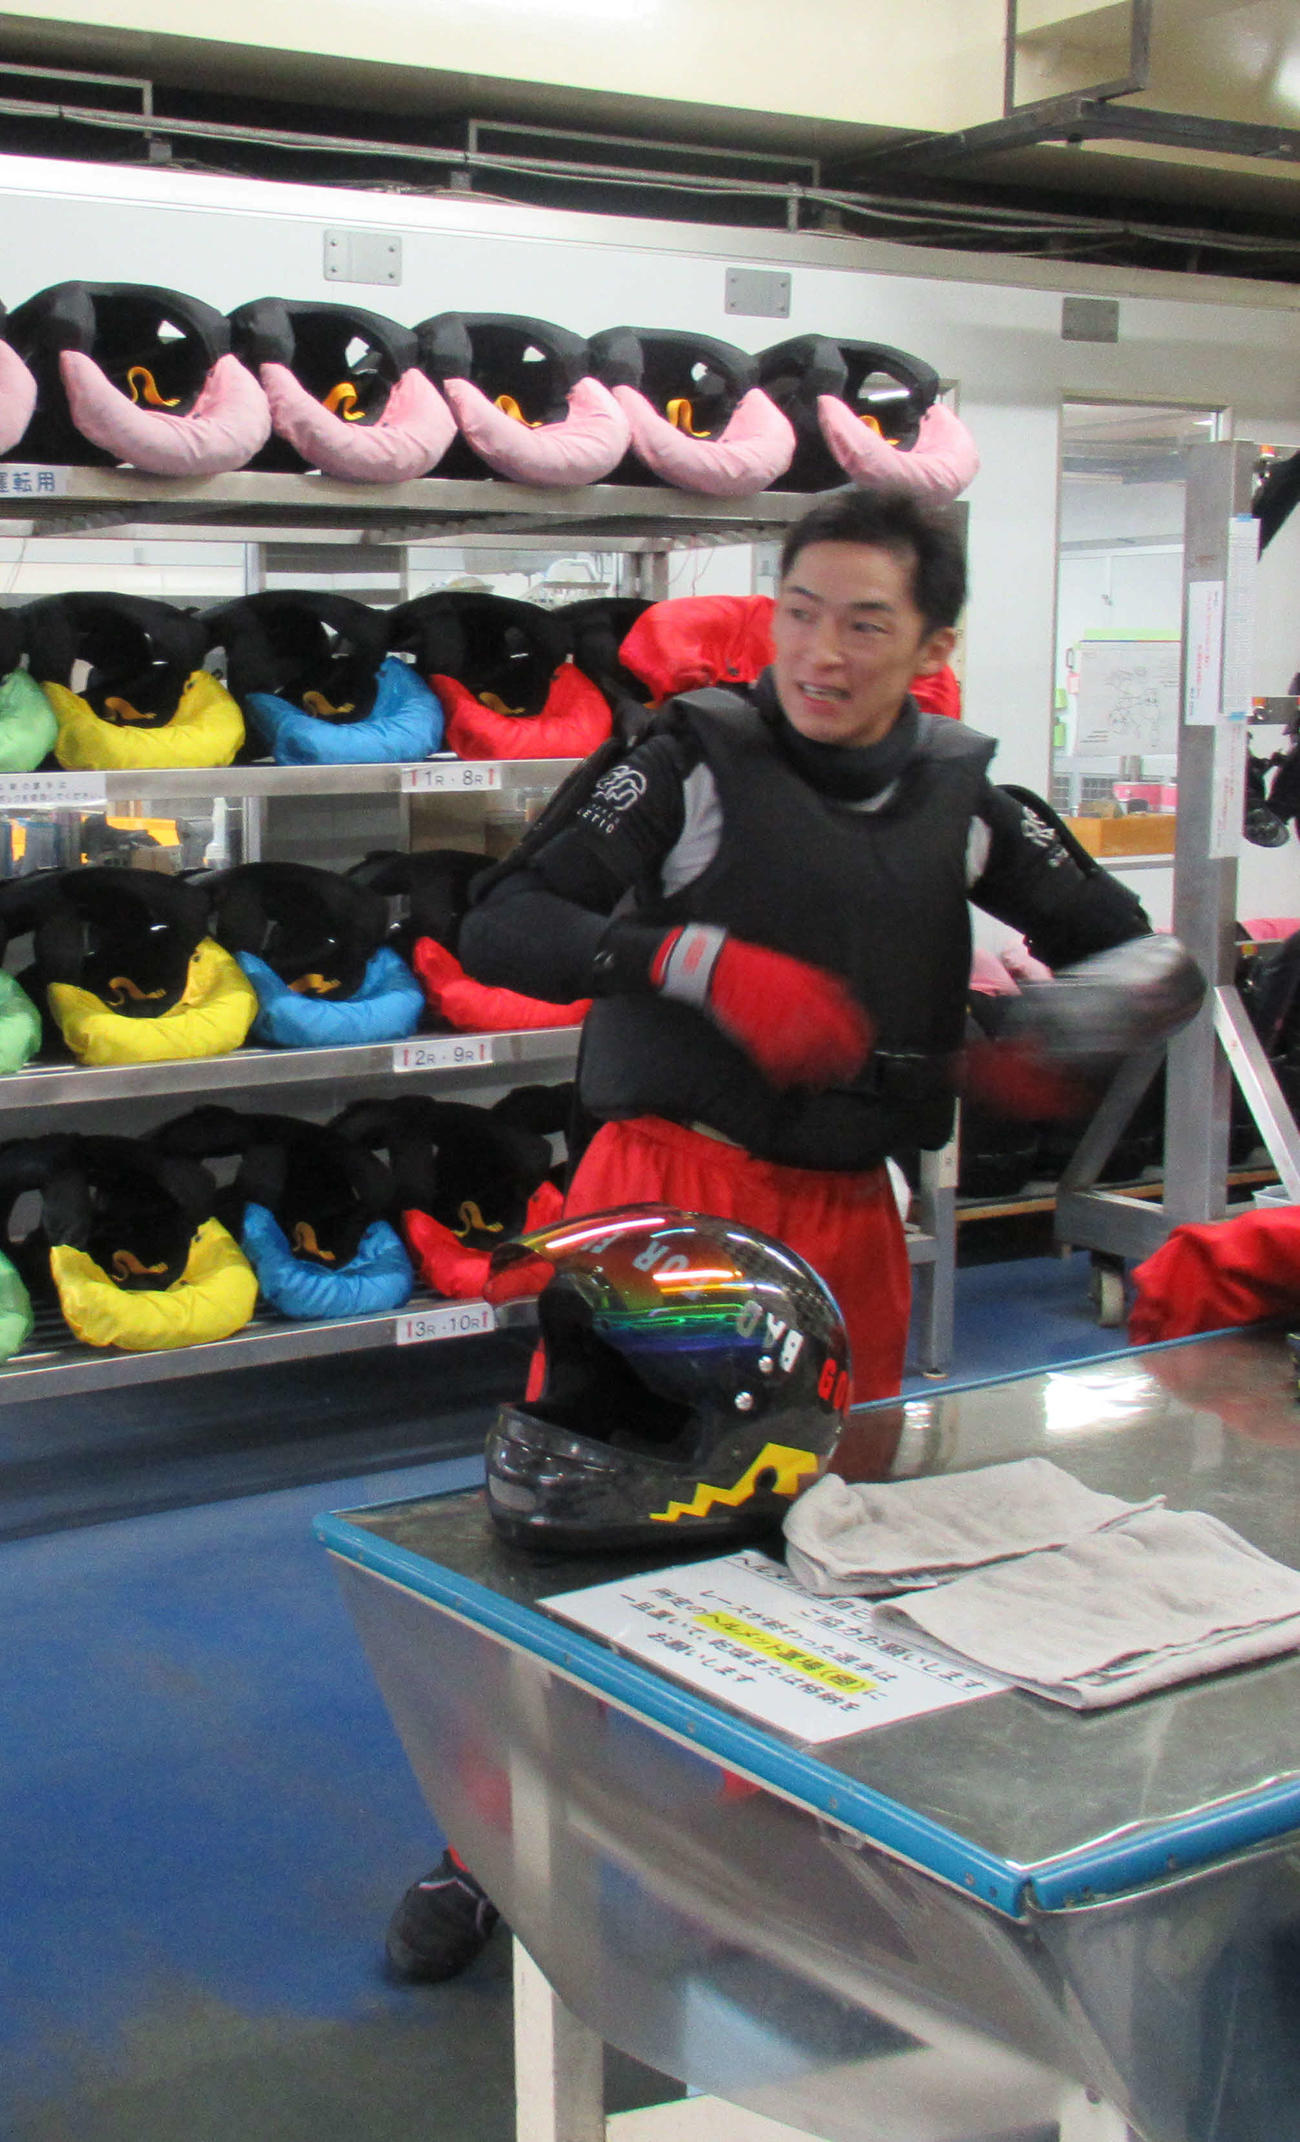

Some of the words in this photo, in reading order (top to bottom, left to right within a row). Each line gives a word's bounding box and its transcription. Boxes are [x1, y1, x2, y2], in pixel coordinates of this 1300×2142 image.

[646, 1632, 757, 1682] お願いします
[700, 1590, 898, 1682] レースが終わった選手は
[801, 1608, 988, 1689] ご協力お願いします
